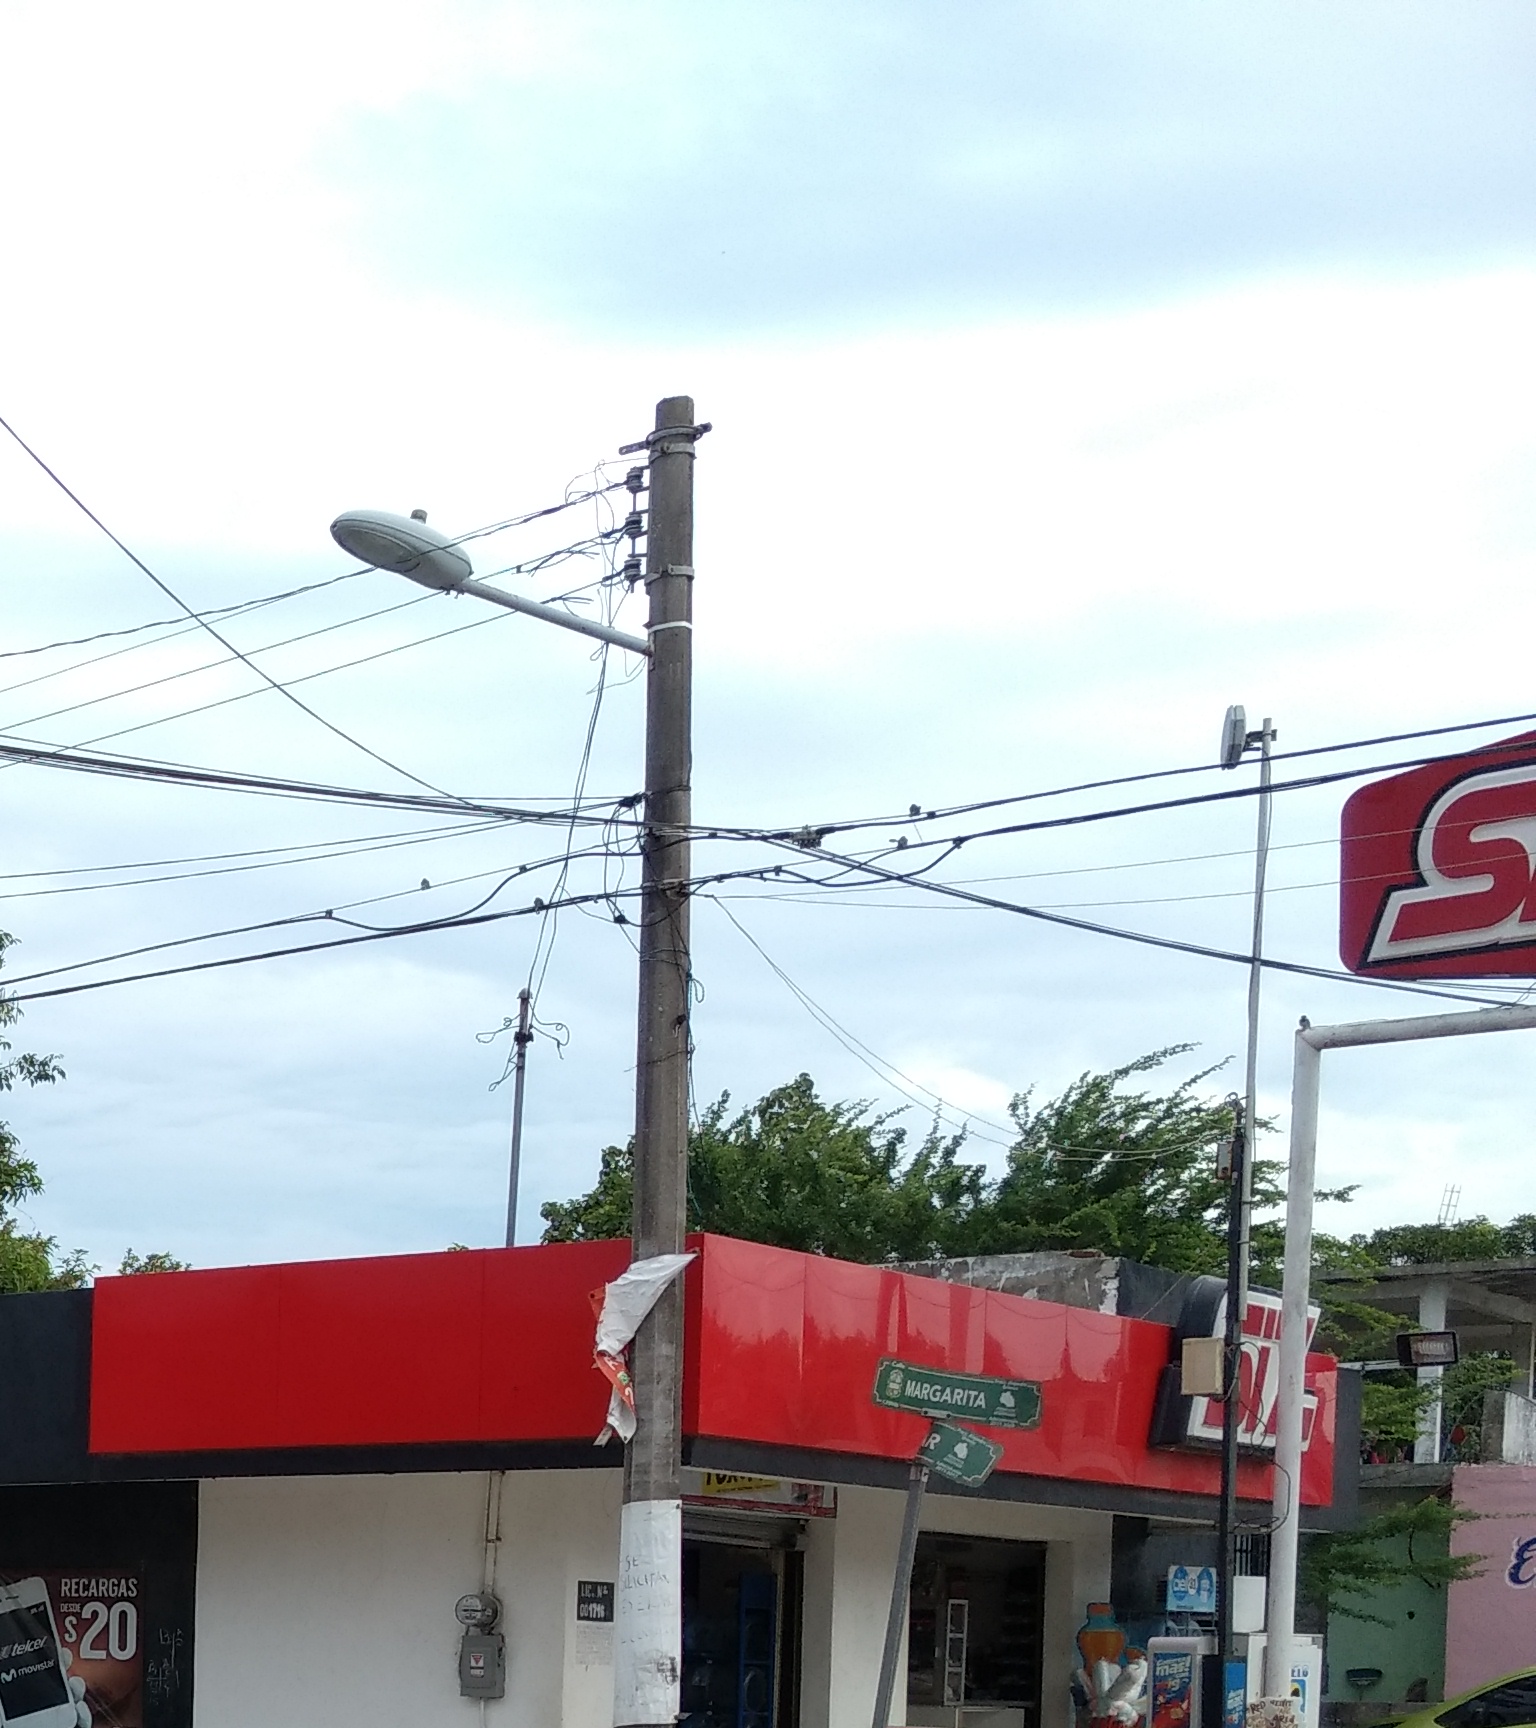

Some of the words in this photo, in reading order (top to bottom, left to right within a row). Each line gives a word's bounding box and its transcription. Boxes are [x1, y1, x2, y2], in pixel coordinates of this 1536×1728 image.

[905, 1380, 986, 1409] MARGARITA
[60, 1578, 138, 1597] RECARGAS
[60, 1603, 81, 1613] DESDE
[64, 1601, 137, 1661] $20
[11, 1636, 47, 1657] telcel
[18, 1659, 55, 1677] movistar
